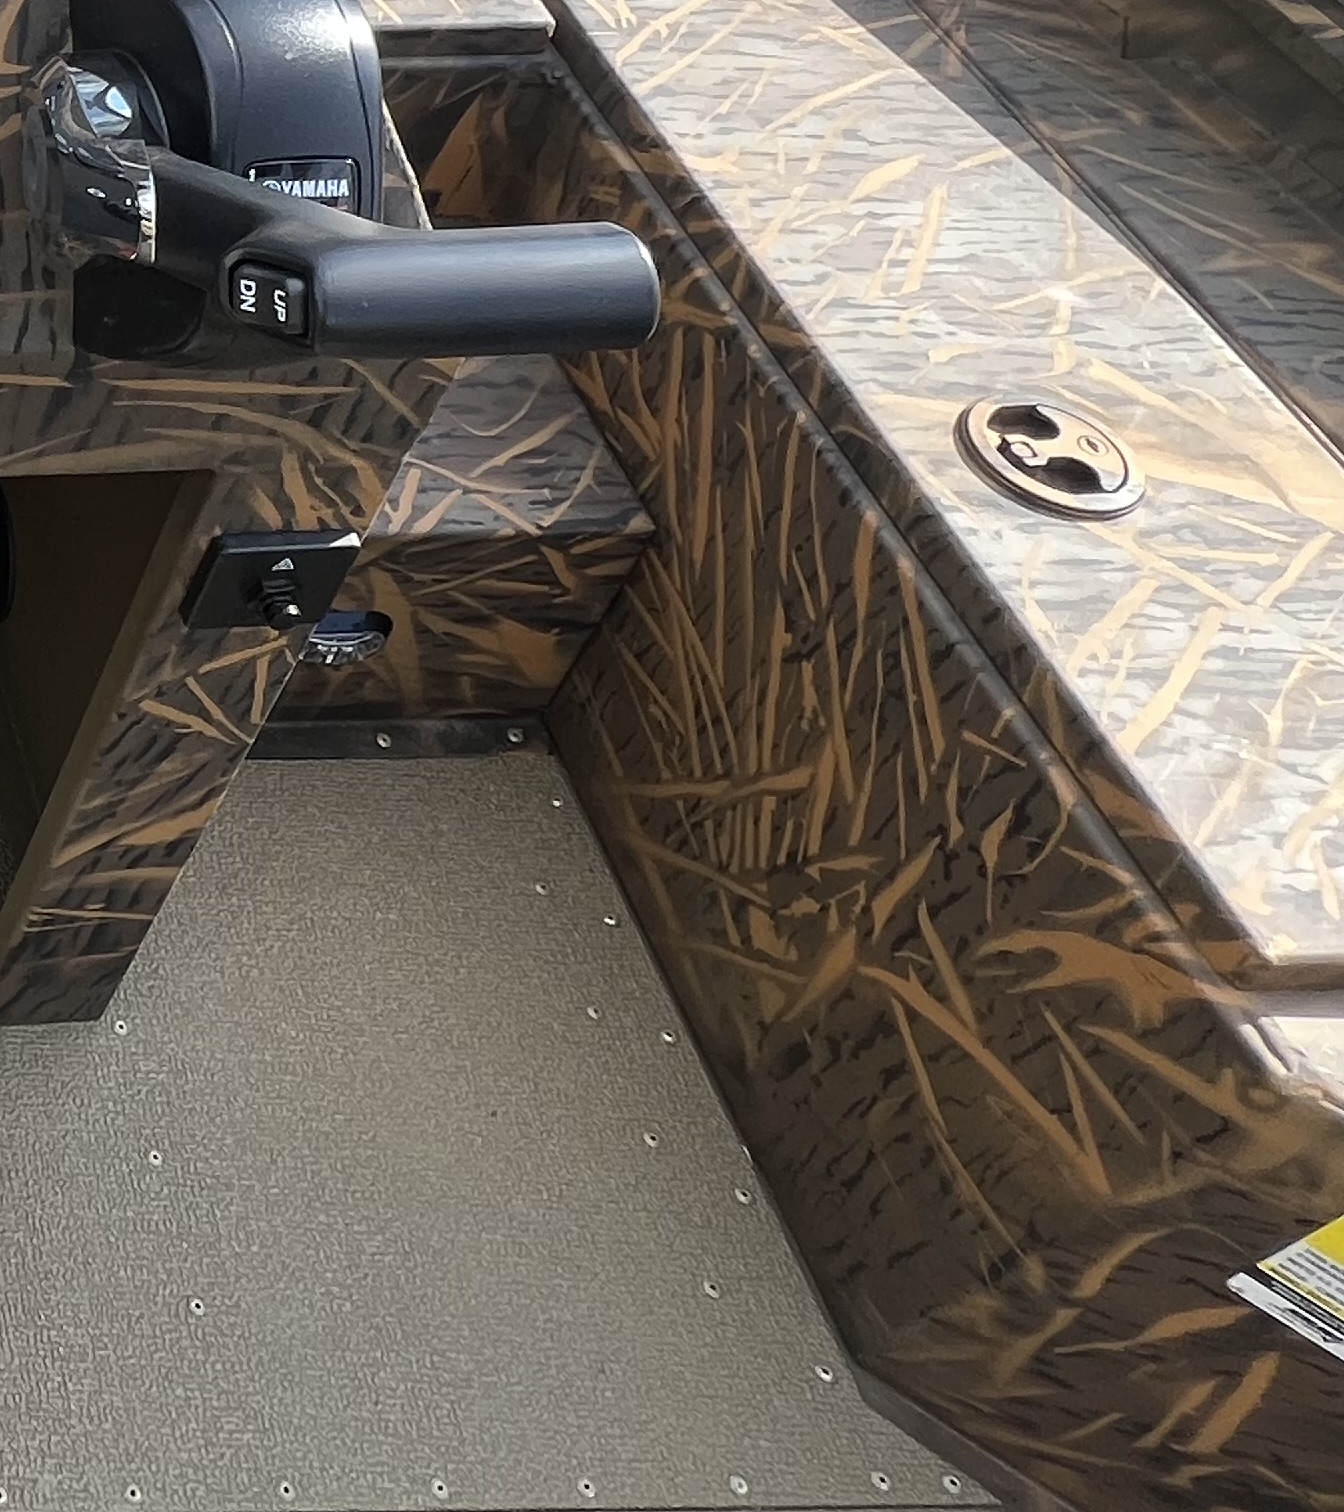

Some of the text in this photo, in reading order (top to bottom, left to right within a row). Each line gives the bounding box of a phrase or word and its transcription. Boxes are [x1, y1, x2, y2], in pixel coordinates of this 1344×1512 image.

[281, 179, 350, 198] YAMAHA
[240, 279, 256, 313] DN
[273, 289, 286, 322] UP
